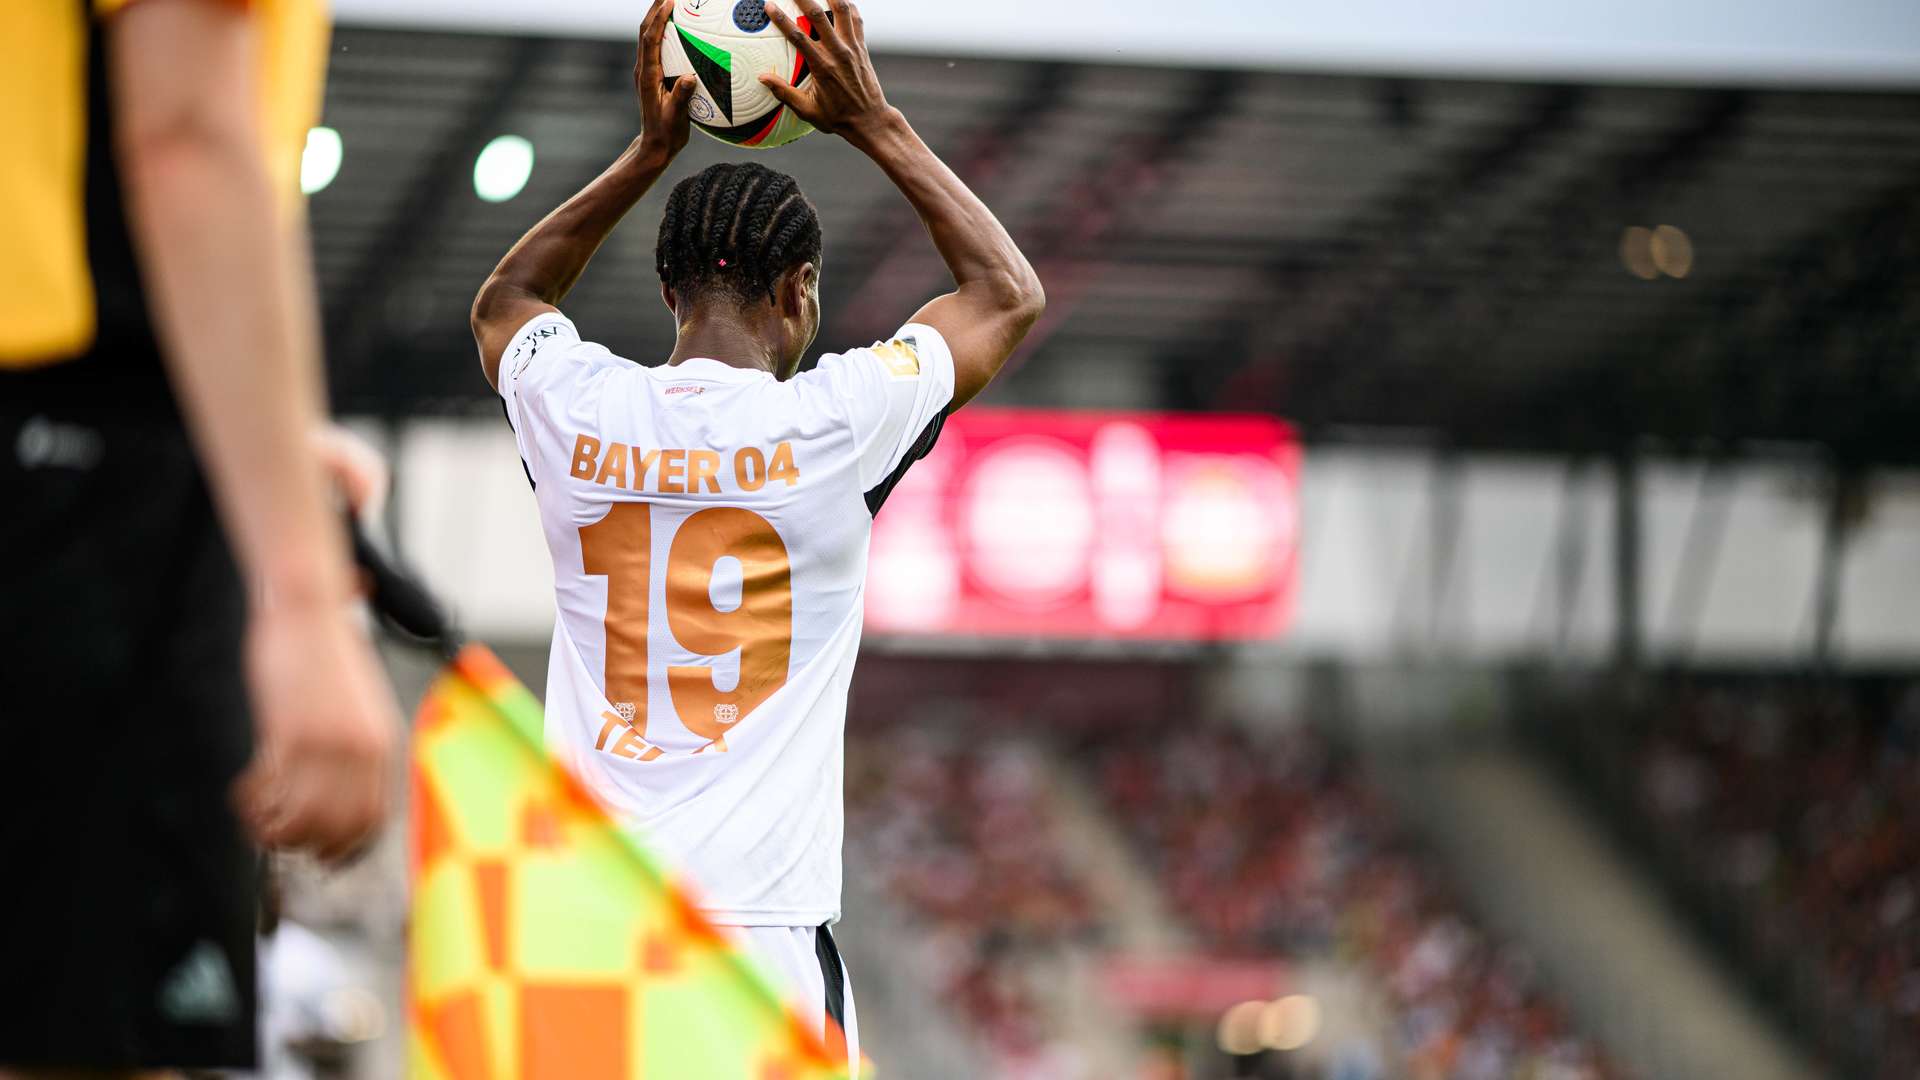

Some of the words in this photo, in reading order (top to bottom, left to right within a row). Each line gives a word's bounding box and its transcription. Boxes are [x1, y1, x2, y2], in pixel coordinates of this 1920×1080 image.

[570, 433, 721, 494] BAYER
[733, 441, 800, 492] 04
[577, 501, 793, 739] 19
